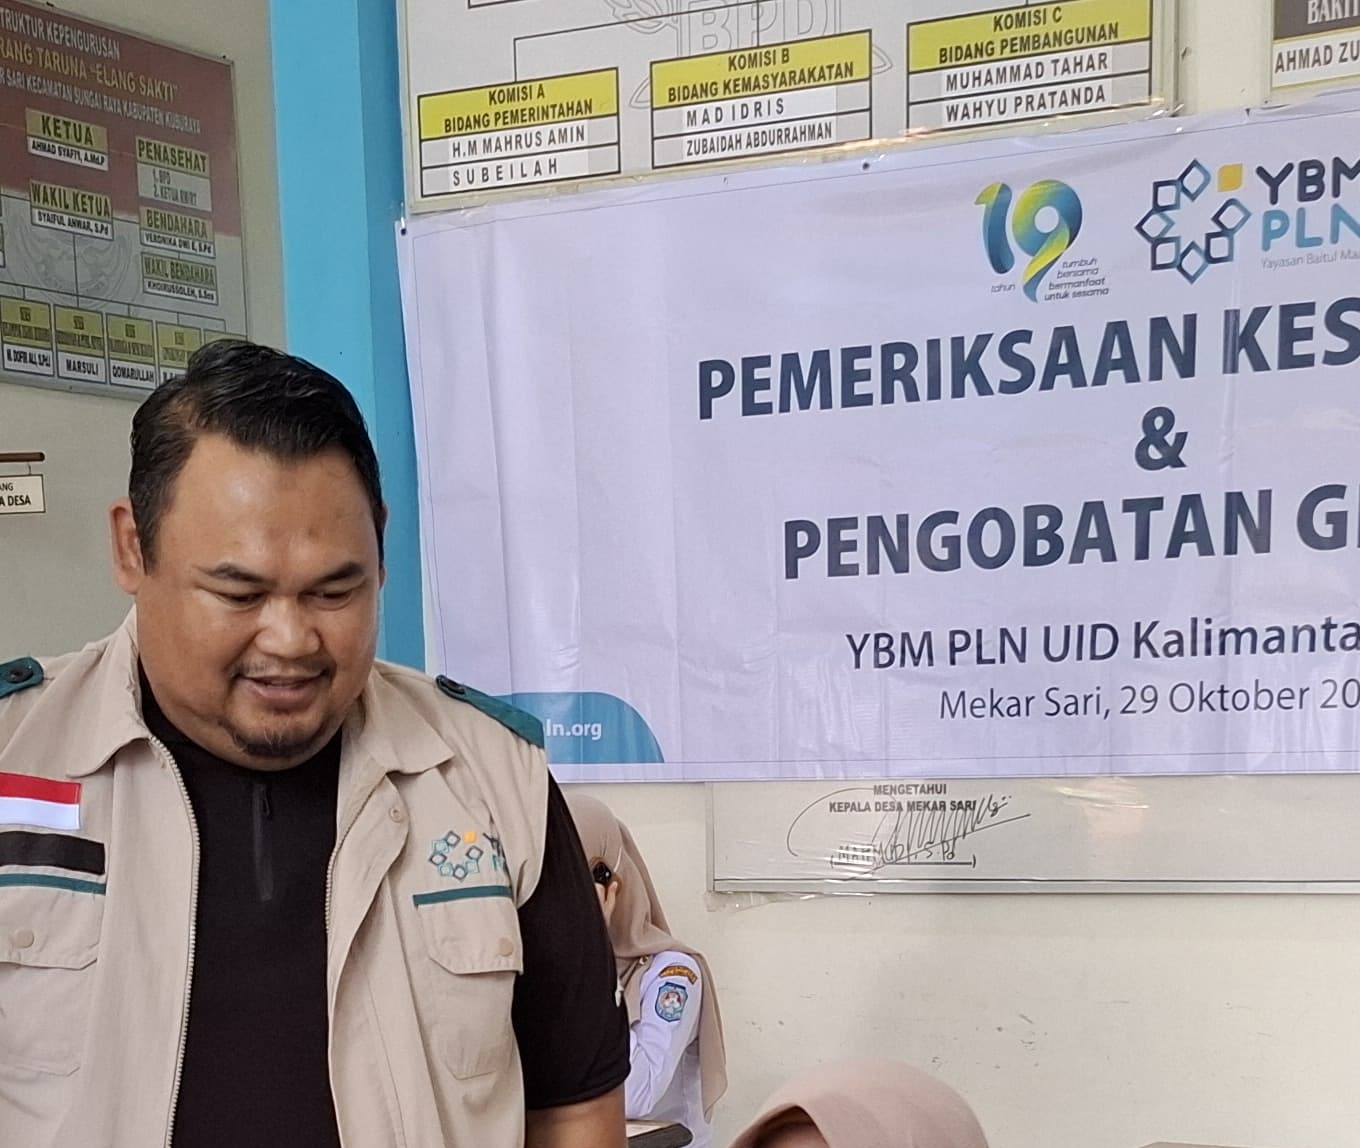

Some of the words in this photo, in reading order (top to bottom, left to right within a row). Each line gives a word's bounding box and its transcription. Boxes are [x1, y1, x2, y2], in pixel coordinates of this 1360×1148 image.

[993, 10, 1047, 32] KOMISI
[1053, 6, 1062, 23] C
[47, 19, 120, 60] KEPENGURUSAN
[940, 41, 994, 64] BIDANG
[1000, 23, 1119, 55] PEMBANGUNAN
[36, 47, 87, 79] TARUNA
[728, 50, 776, 71] KOMISI
[781, 48, 790, 63] B
[946, 63, 1044, 92] MUHAMMAD
[1052, 52, 1108, 77] TAHAR
[1275, 45, 1333, 73] AHMAD
[488, 88, 535, 106] KOMISI
[537, 84, 546, 100] A
[668, 82, 718, 103] BIDANG
[723, 62, 854, 96] KEMASYARAKATAN
[444, 113, 491, 134] BIDANG
[494, 99, 593, 128] PEMERINTAHAN
[687, 106, 723, 127] MAD
[732, 98, 785, 121] IDRIS
[946, 99, 1007, 122] WAHYU
[1014, 85, 1105, 114] PRATANDA
[42, 115, 93, 145] KETUA
[452, 139, 479, 159] H.M
[482, 134, 543, 155] MAHRUS
[548, 125, 586, 146] AMIN
[687, 133, 742, 157] ZUBAIDAH
[746, 122, 832, 149] ABDURRAHMAN
[138, 139, 207, 173] PENASEHAT
[452, 157, 559, 187] SUBEILAH
[32, 182, 69, 210] WAKIL
[72, 190, 110, 217] KETUA
[147, 209, 207, 239] BENDAHARA
[1057, 268, 1099, 279] bersama
[1062, 258, 1097, 269] tumbuh
[1260, 256, 1301, 271] Yayasan
[1303, 251, 1337, 266] Baitul
[991, 284, 1016, 293] tahun
[1044, 291, 1070, 301] untuk
[1072, 287, 1109, 299] sesama
[1049, 278, 1105, 290] bermanfaat
[66, 359, 99, 376] MARSULI
[698, 314, 1197, 420] PEMERIKSAAN
[1134, 406, 1188, 469] &
[7, 495, 31, 506] DESA
[783, 488, 1271, 580] PENGOBATAN
[846, 631, 935, 670] YBM
[948, 625, 1028, 666] PLN
[1043, 621, 1120, 663] UID
[939, 684, 1035, 720] Mekar
[1044, 682, 1110, 721] Sari,
[1120, 682, 1159, 716] 29
[1169, 677, 1310, 714] Oktober
[546, 718, 602, 740] ln.org
[873, 783, 947, 796] MENGETAHUI
[829, 800, 871, 813] KEPALA
[874, 800, 903, 812] DESA
[907, 800, 947, 812] MEKAR
[950, 799, 976, 812] SARI
